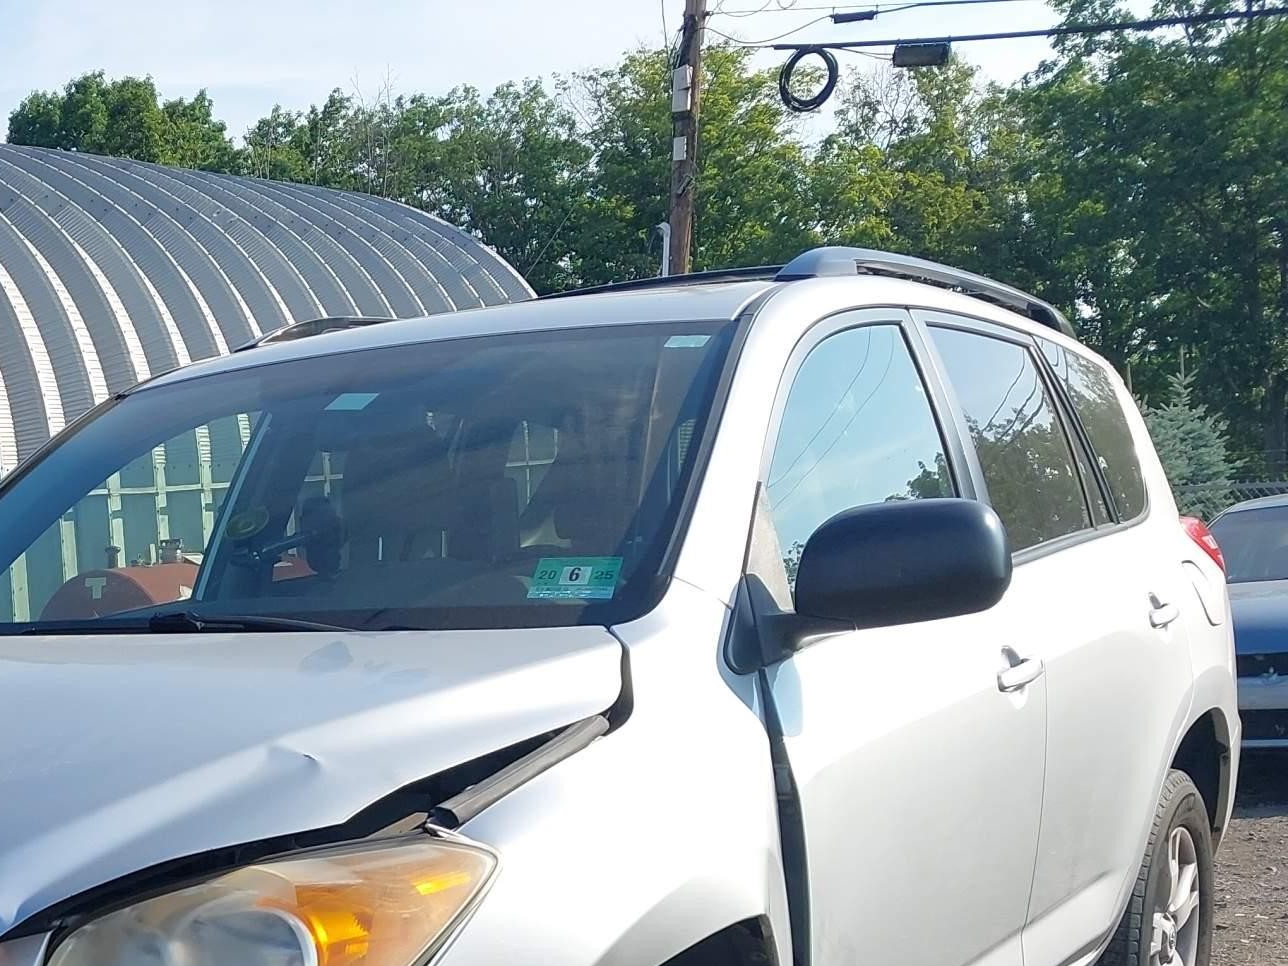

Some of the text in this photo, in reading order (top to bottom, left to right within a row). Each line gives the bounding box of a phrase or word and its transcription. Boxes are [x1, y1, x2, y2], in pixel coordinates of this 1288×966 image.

[538, 567, 614, 582] 20 6 25
